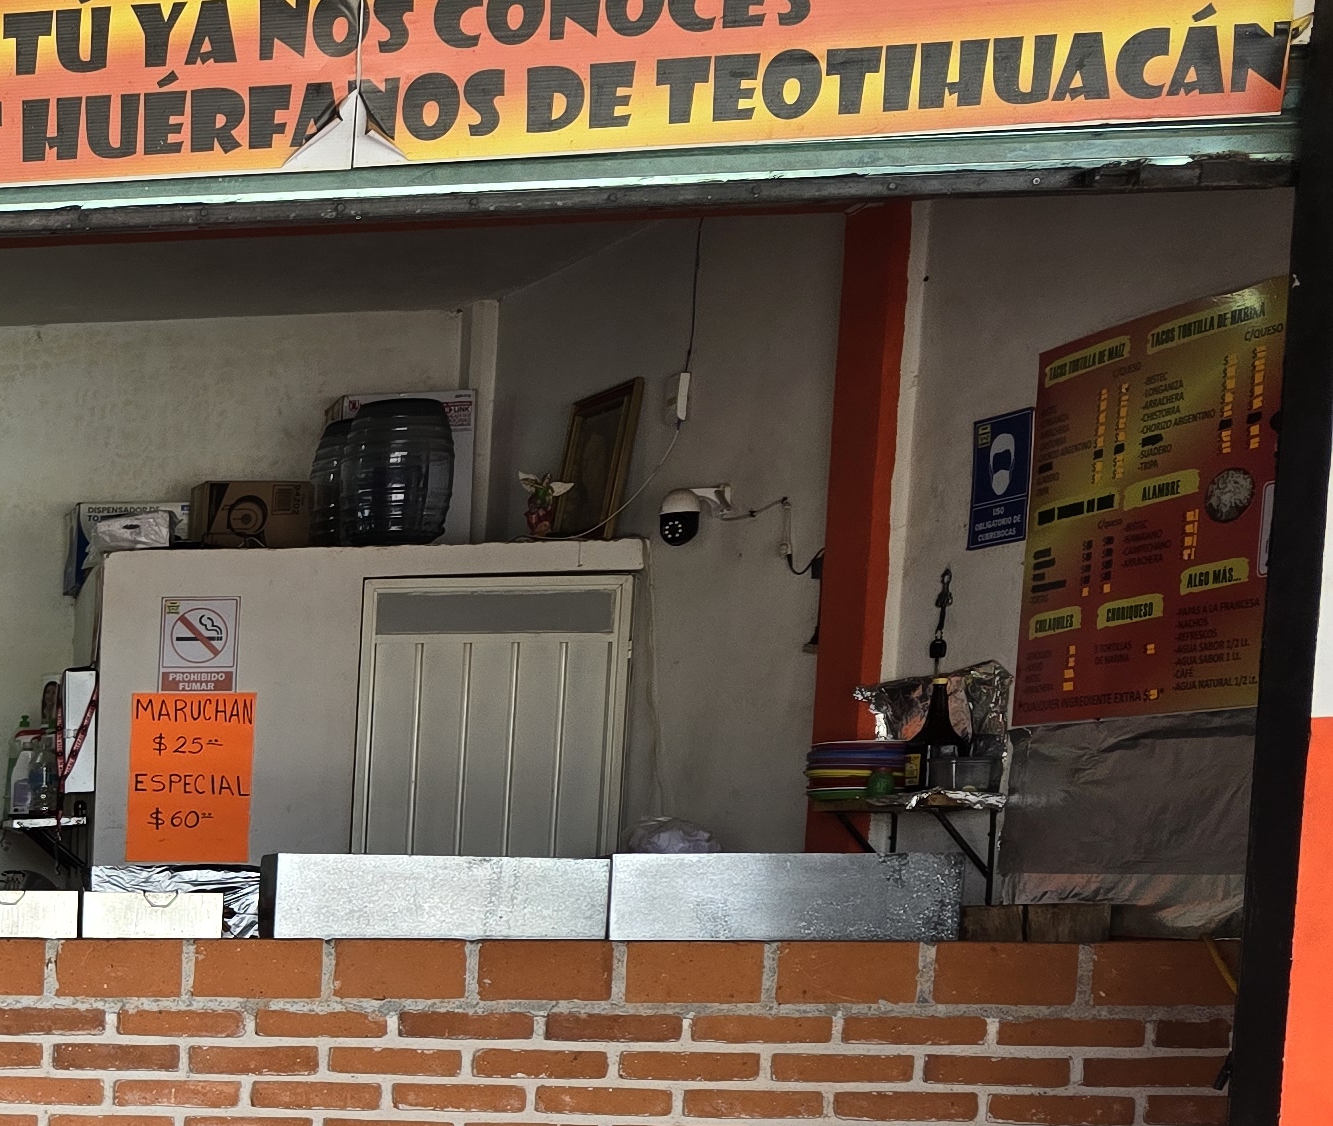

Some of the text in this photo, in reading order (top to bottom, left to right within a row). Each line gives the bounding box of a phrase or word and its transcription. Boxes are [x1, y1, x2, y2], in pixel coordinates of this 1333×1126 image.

[2, 0, 112, 76] TÚ
[131, 0, 239, 68] YA
[259, 0, 413, 62] NOS
[23, 69, 505, 164] HUÉRFANOS
[526, 62, 636, 135] DE
[656, 5, 1292, 126] TEOTIHUACÁN
[1151, 328, 1175, 348] TACOS
[1178, 316, 1215, 339] TORTILLA
[1217, 312, 1228, 328] DE
[1141, 478, 1181, 502] ALAMBRE
[992, 505, 1005, 516] USO
[1013, 514, 1022, 523] DE
[1187, 570, 1210, 588] ALGO
[1106, 602, 1154, 623] CHORIQUESO
[169, 673, 226, 681] PROHIBIDO
[179, 682, 215, 691] FUMAR
[135, 697, 255, 725] MARUCHAN
[134, 774, 250, 796] ESPECIAL
